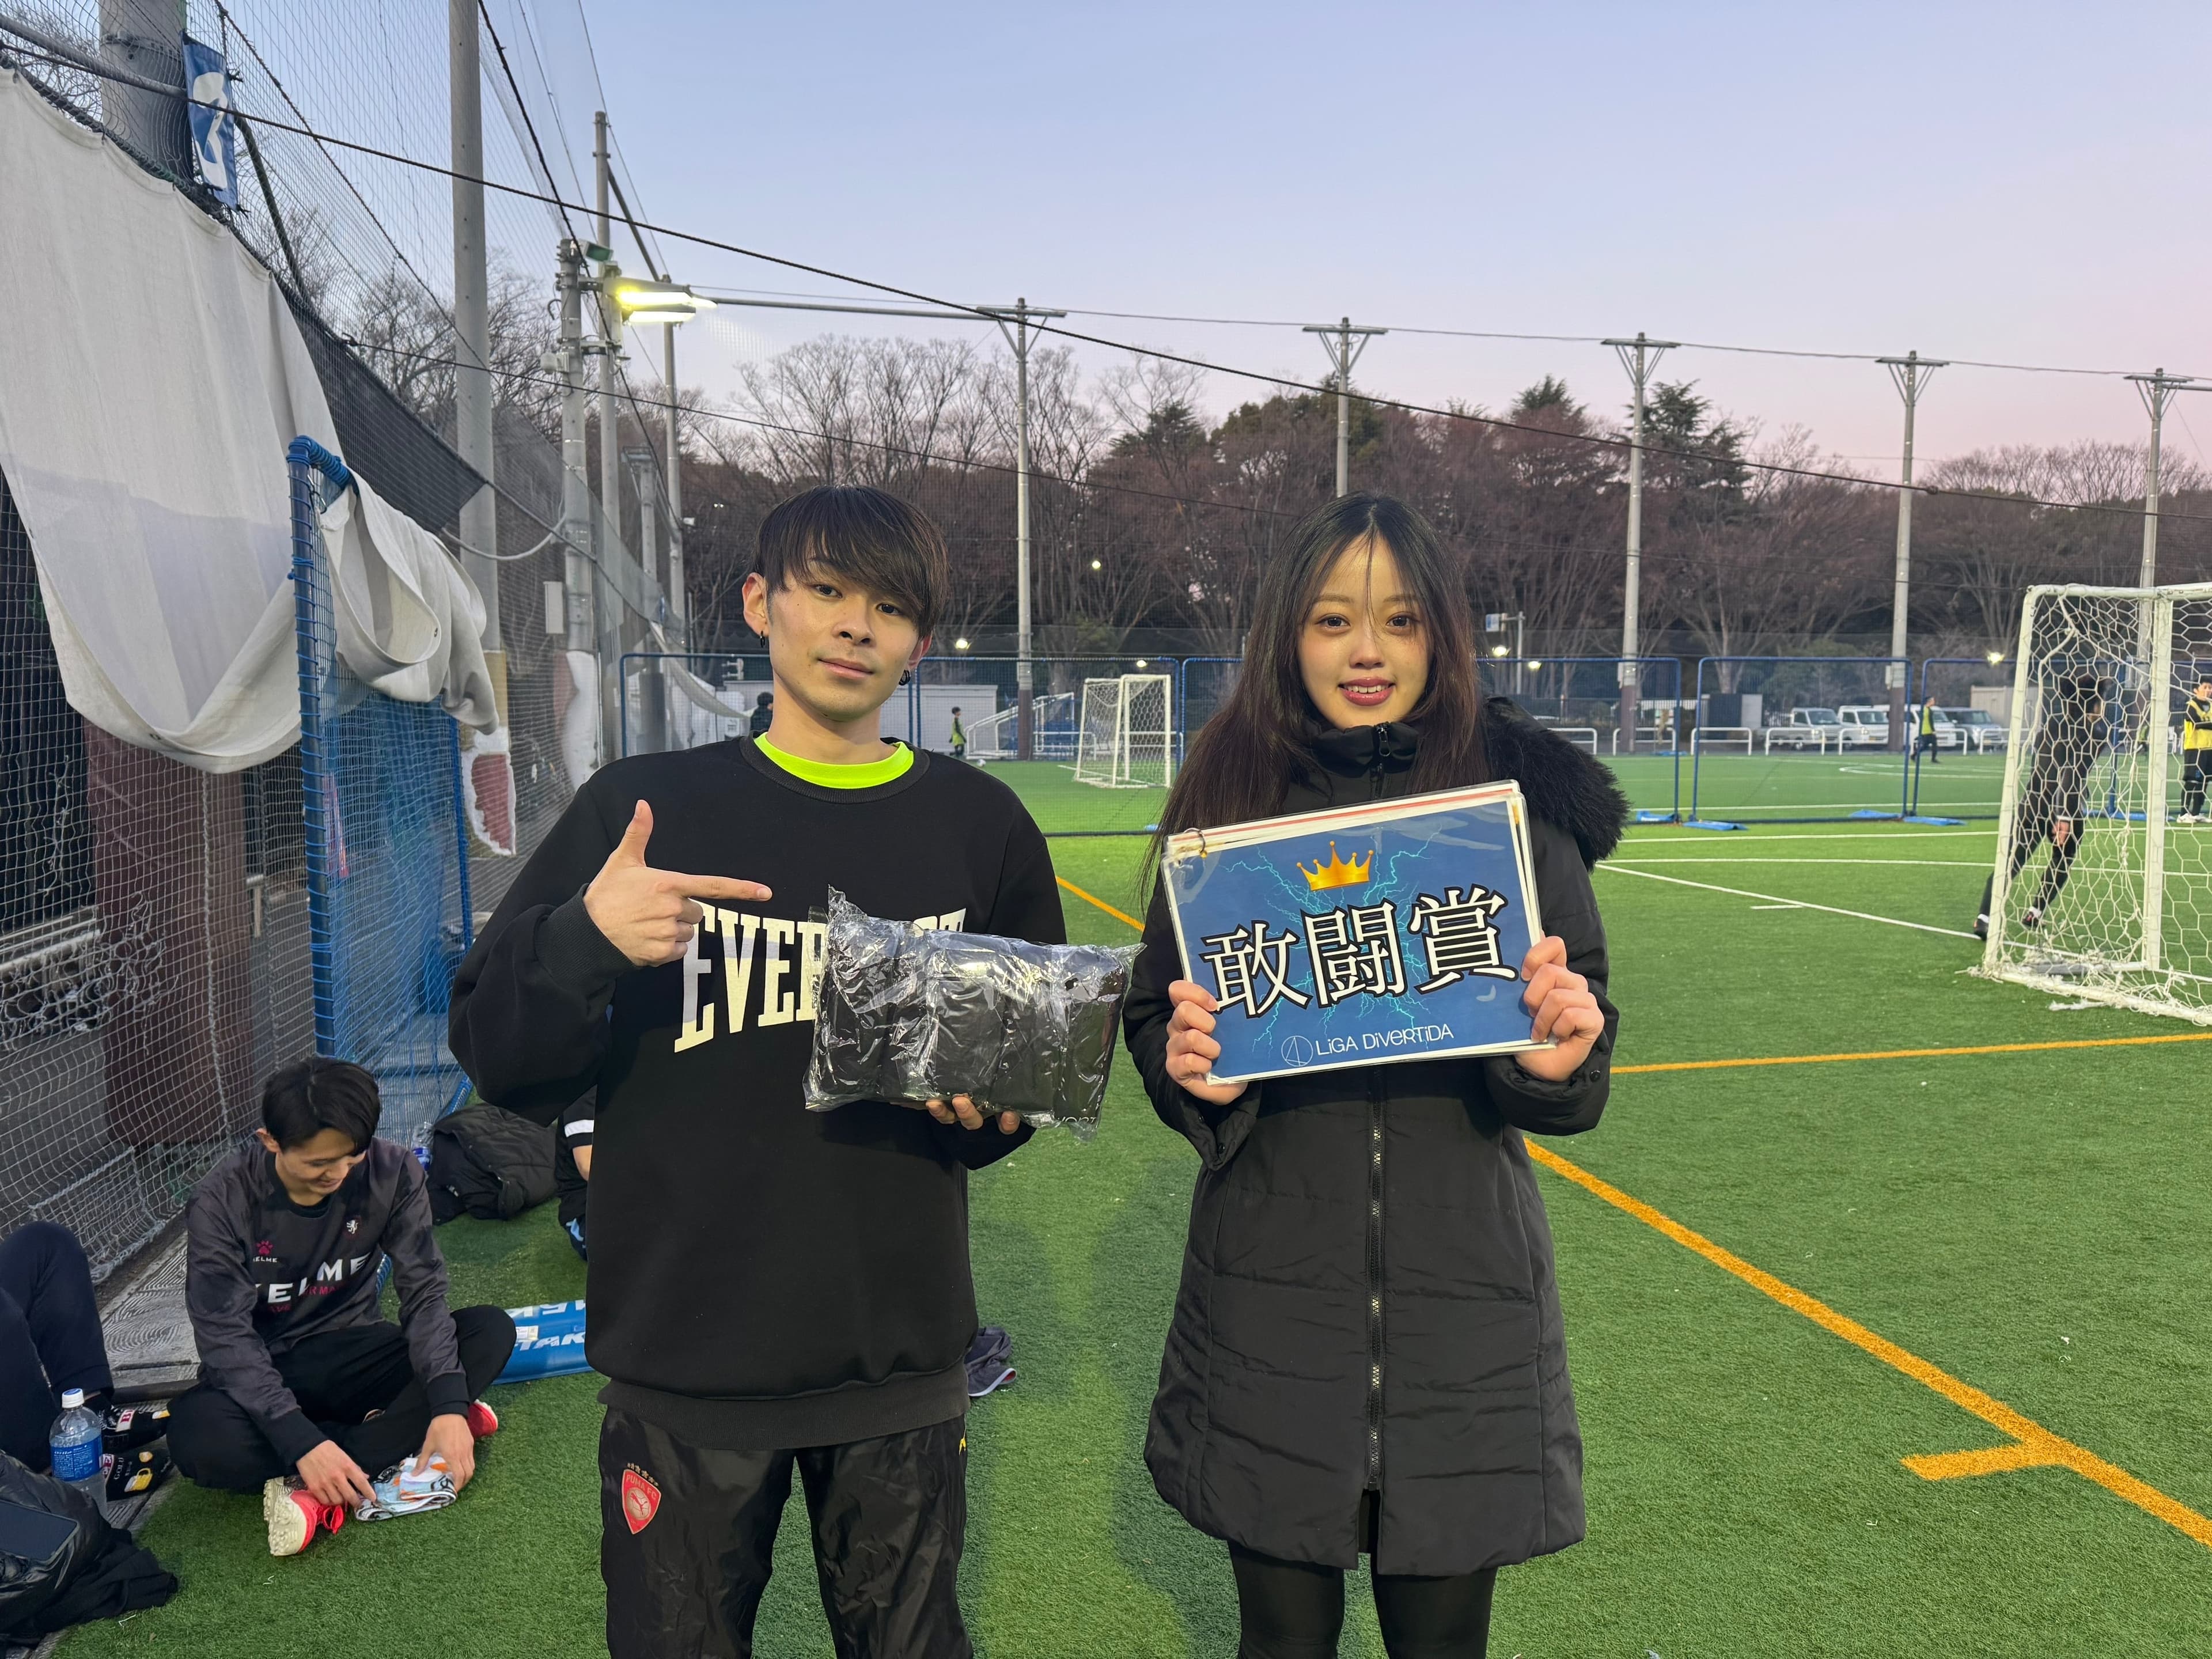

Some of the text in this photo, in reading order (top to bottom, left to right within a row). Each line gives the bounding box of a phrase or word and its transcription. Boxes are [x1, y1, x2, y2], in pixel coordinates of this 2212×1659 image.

[674, 897, 967, 1052] EVER
[1199, 884, 1518, 1018] 敢闘賞
[626, 1474, 657, 1501] PUMA FC
